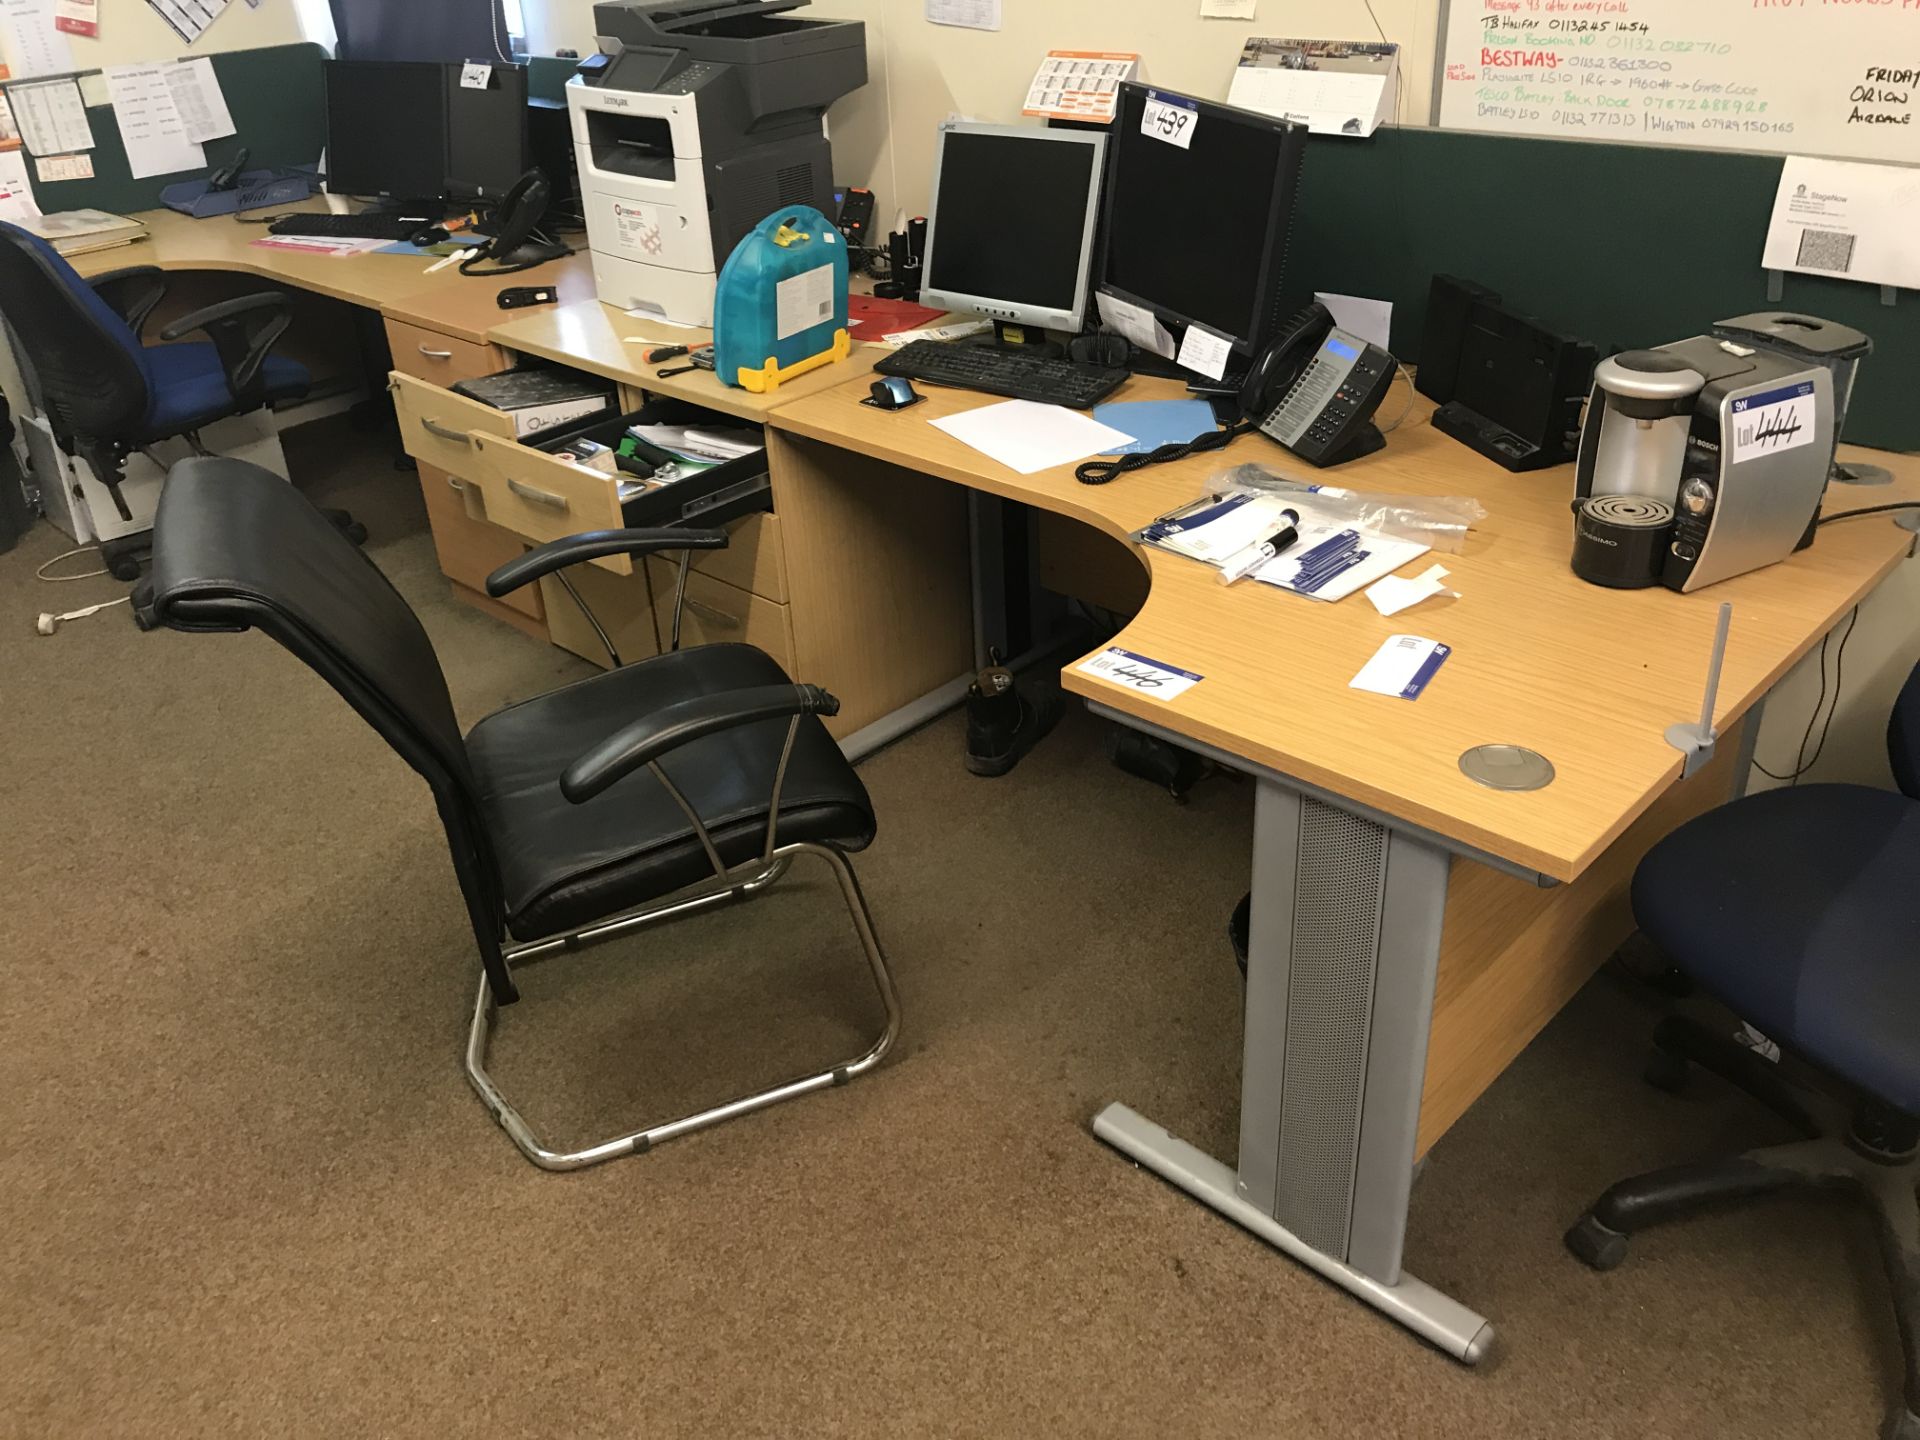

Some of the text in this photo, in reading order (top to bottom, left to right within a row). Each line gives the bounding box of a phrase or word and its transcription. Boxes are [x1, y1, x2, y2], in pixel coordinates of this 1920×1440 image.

[1157, 107, 1188, 138] 439
[1737, 405, 1802, 449] Lot 444
[1697, 439, 1719, 452] BOSCH
